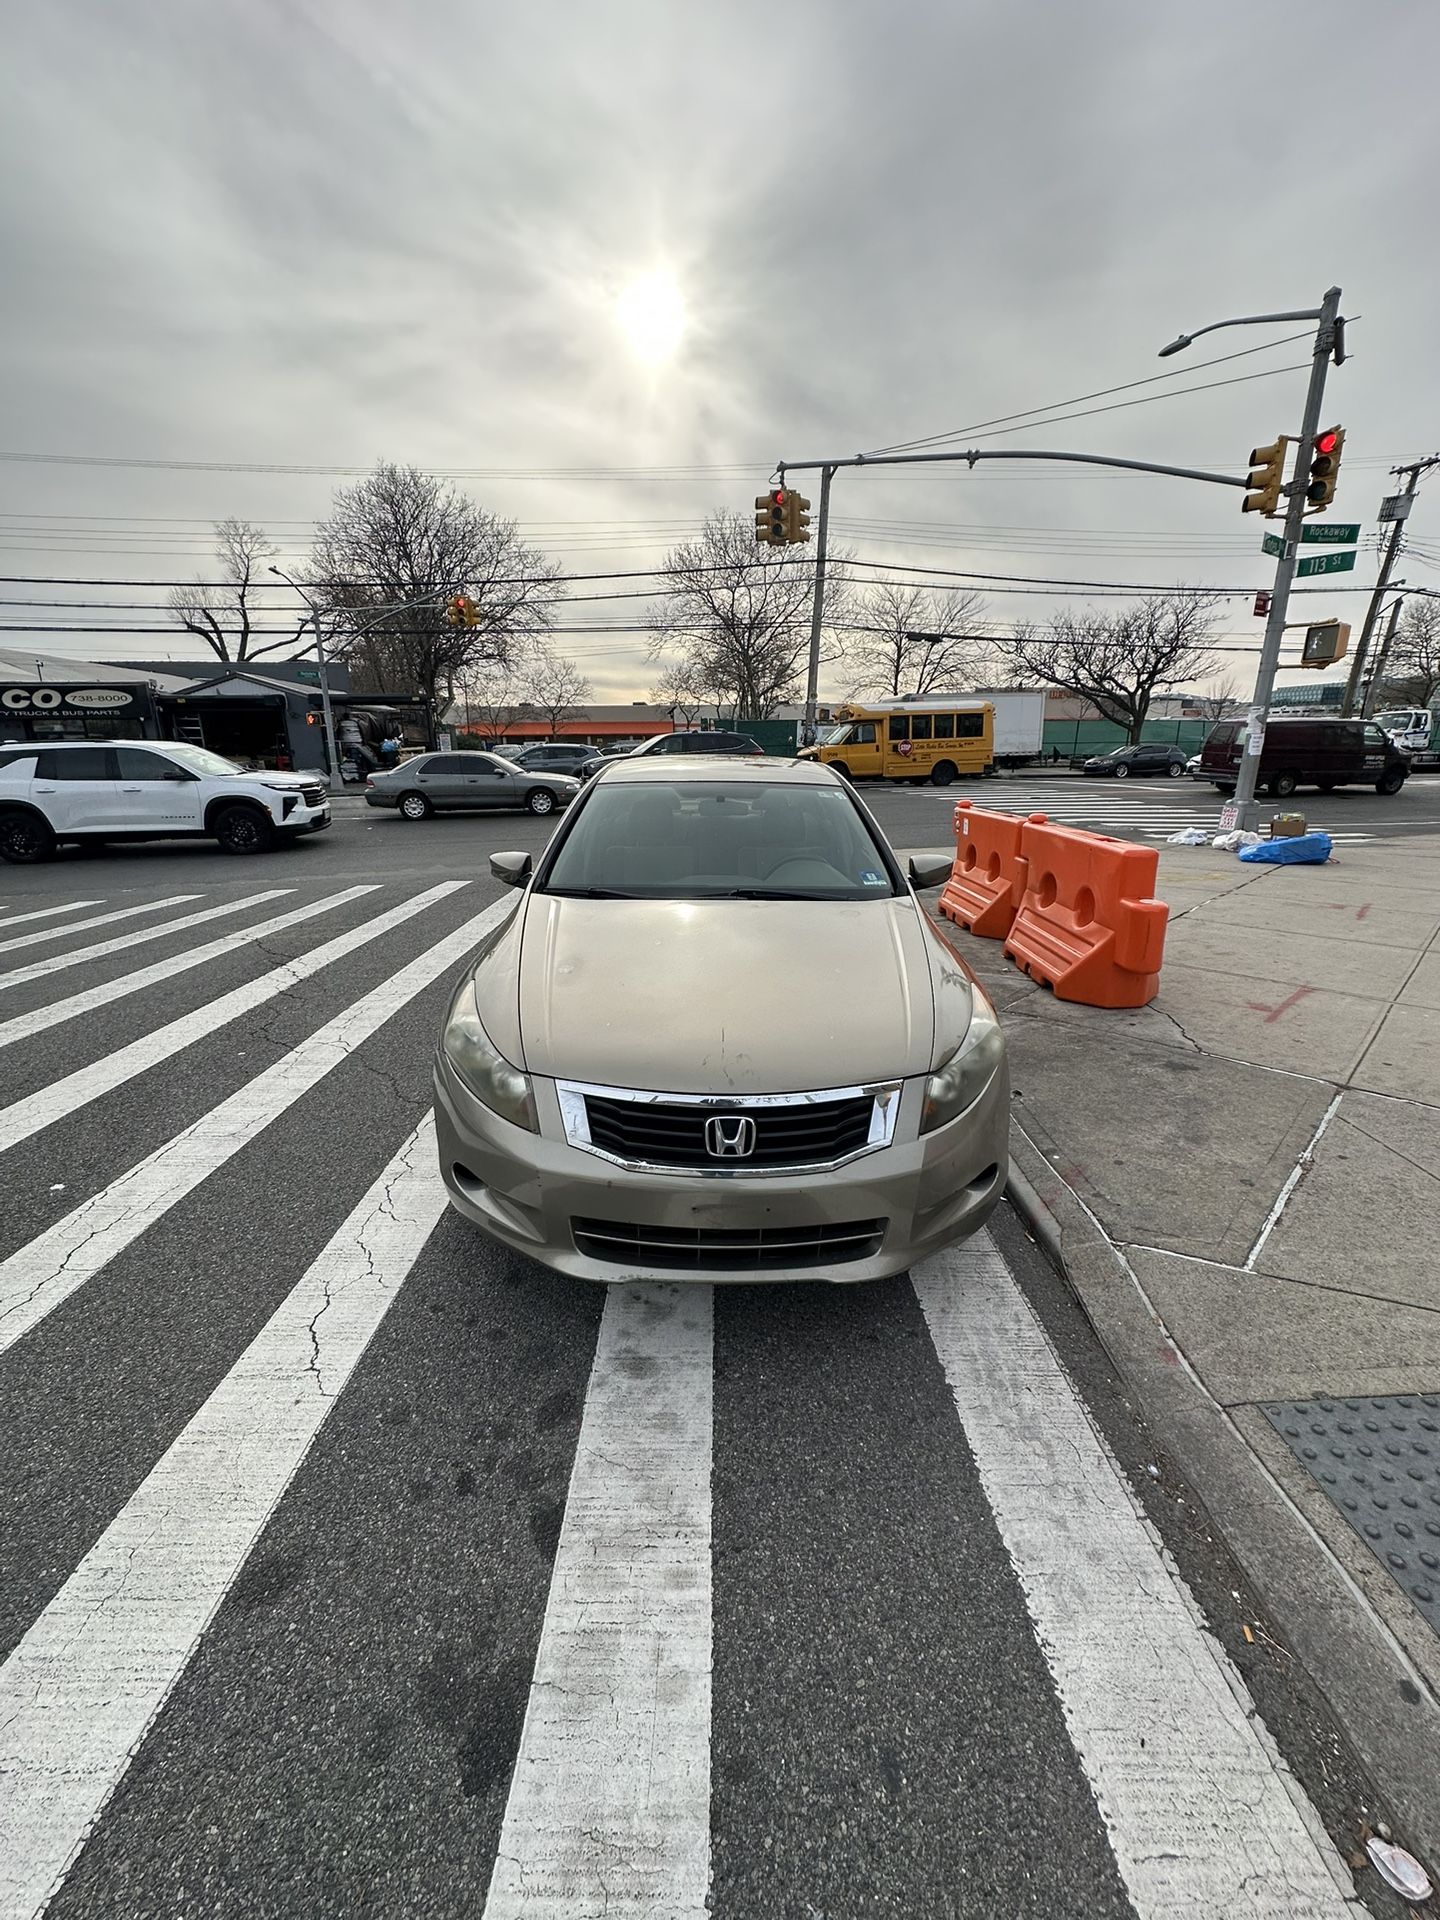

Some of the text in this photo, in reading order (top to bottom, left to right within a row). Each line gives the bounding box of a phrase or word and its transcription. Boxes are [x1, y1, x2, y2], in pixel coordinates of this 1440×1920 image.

[1309, 525, 1351, 539] Rockaway
[1309, 555, 1342, 574] 113 St
[1, 688, 62, 709] CO
